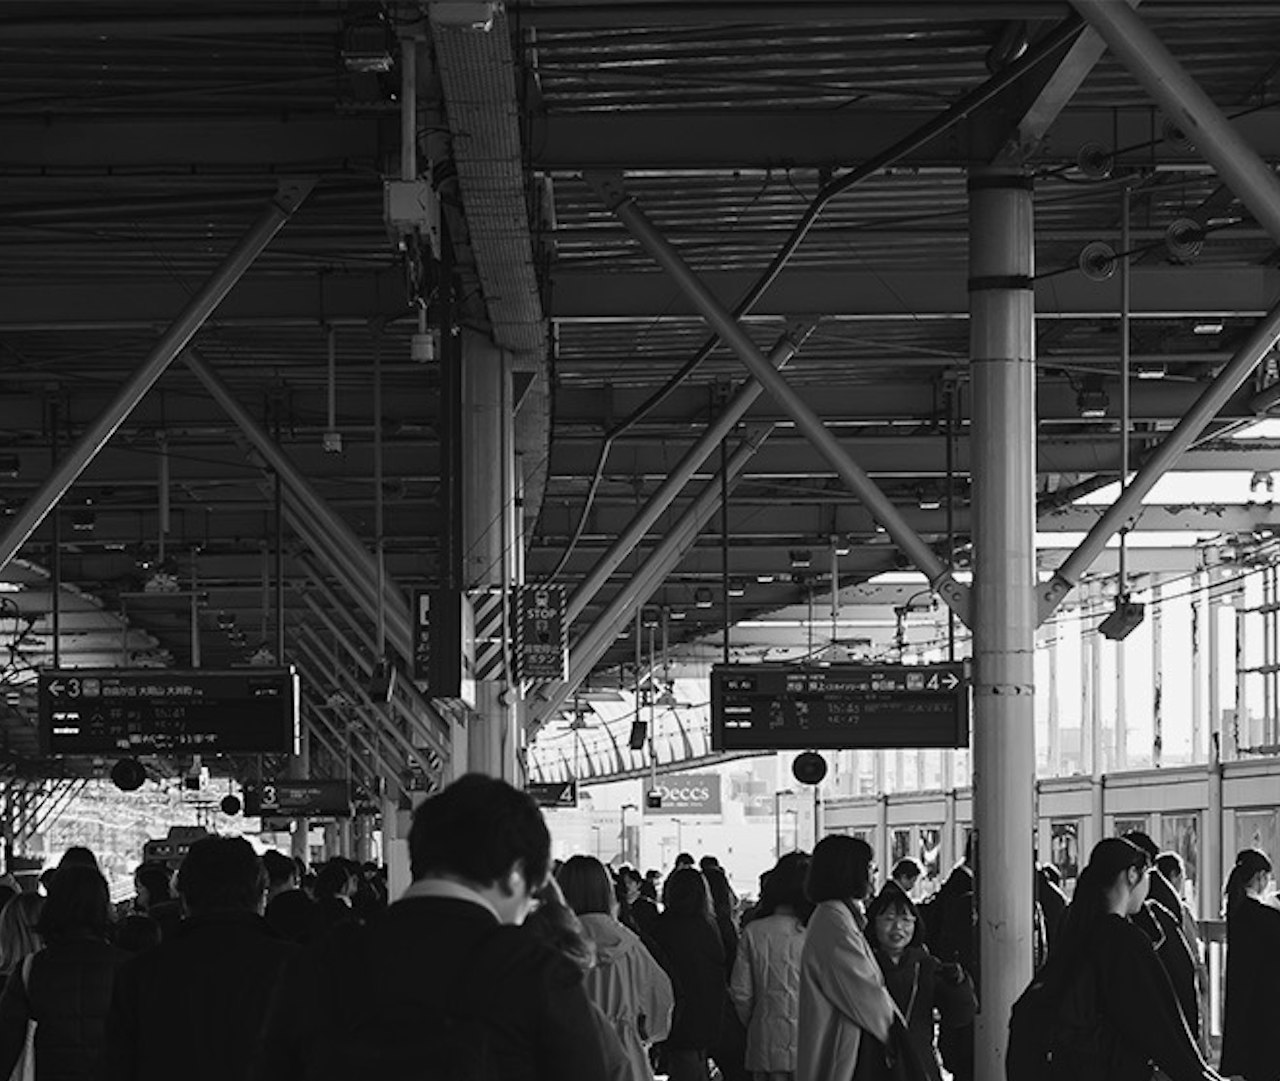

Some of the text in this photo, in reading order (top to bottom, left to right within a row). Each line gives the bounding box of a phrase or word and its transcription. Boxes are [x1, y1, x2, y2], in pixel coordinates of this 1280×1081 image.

[527, 608, 558, 620] STOP
[67, 678, 81, 698] 3
[926, 674, 940, 691] 4
[260, 785, 276, 805] 3
[559, 785, 572, 802] 4
